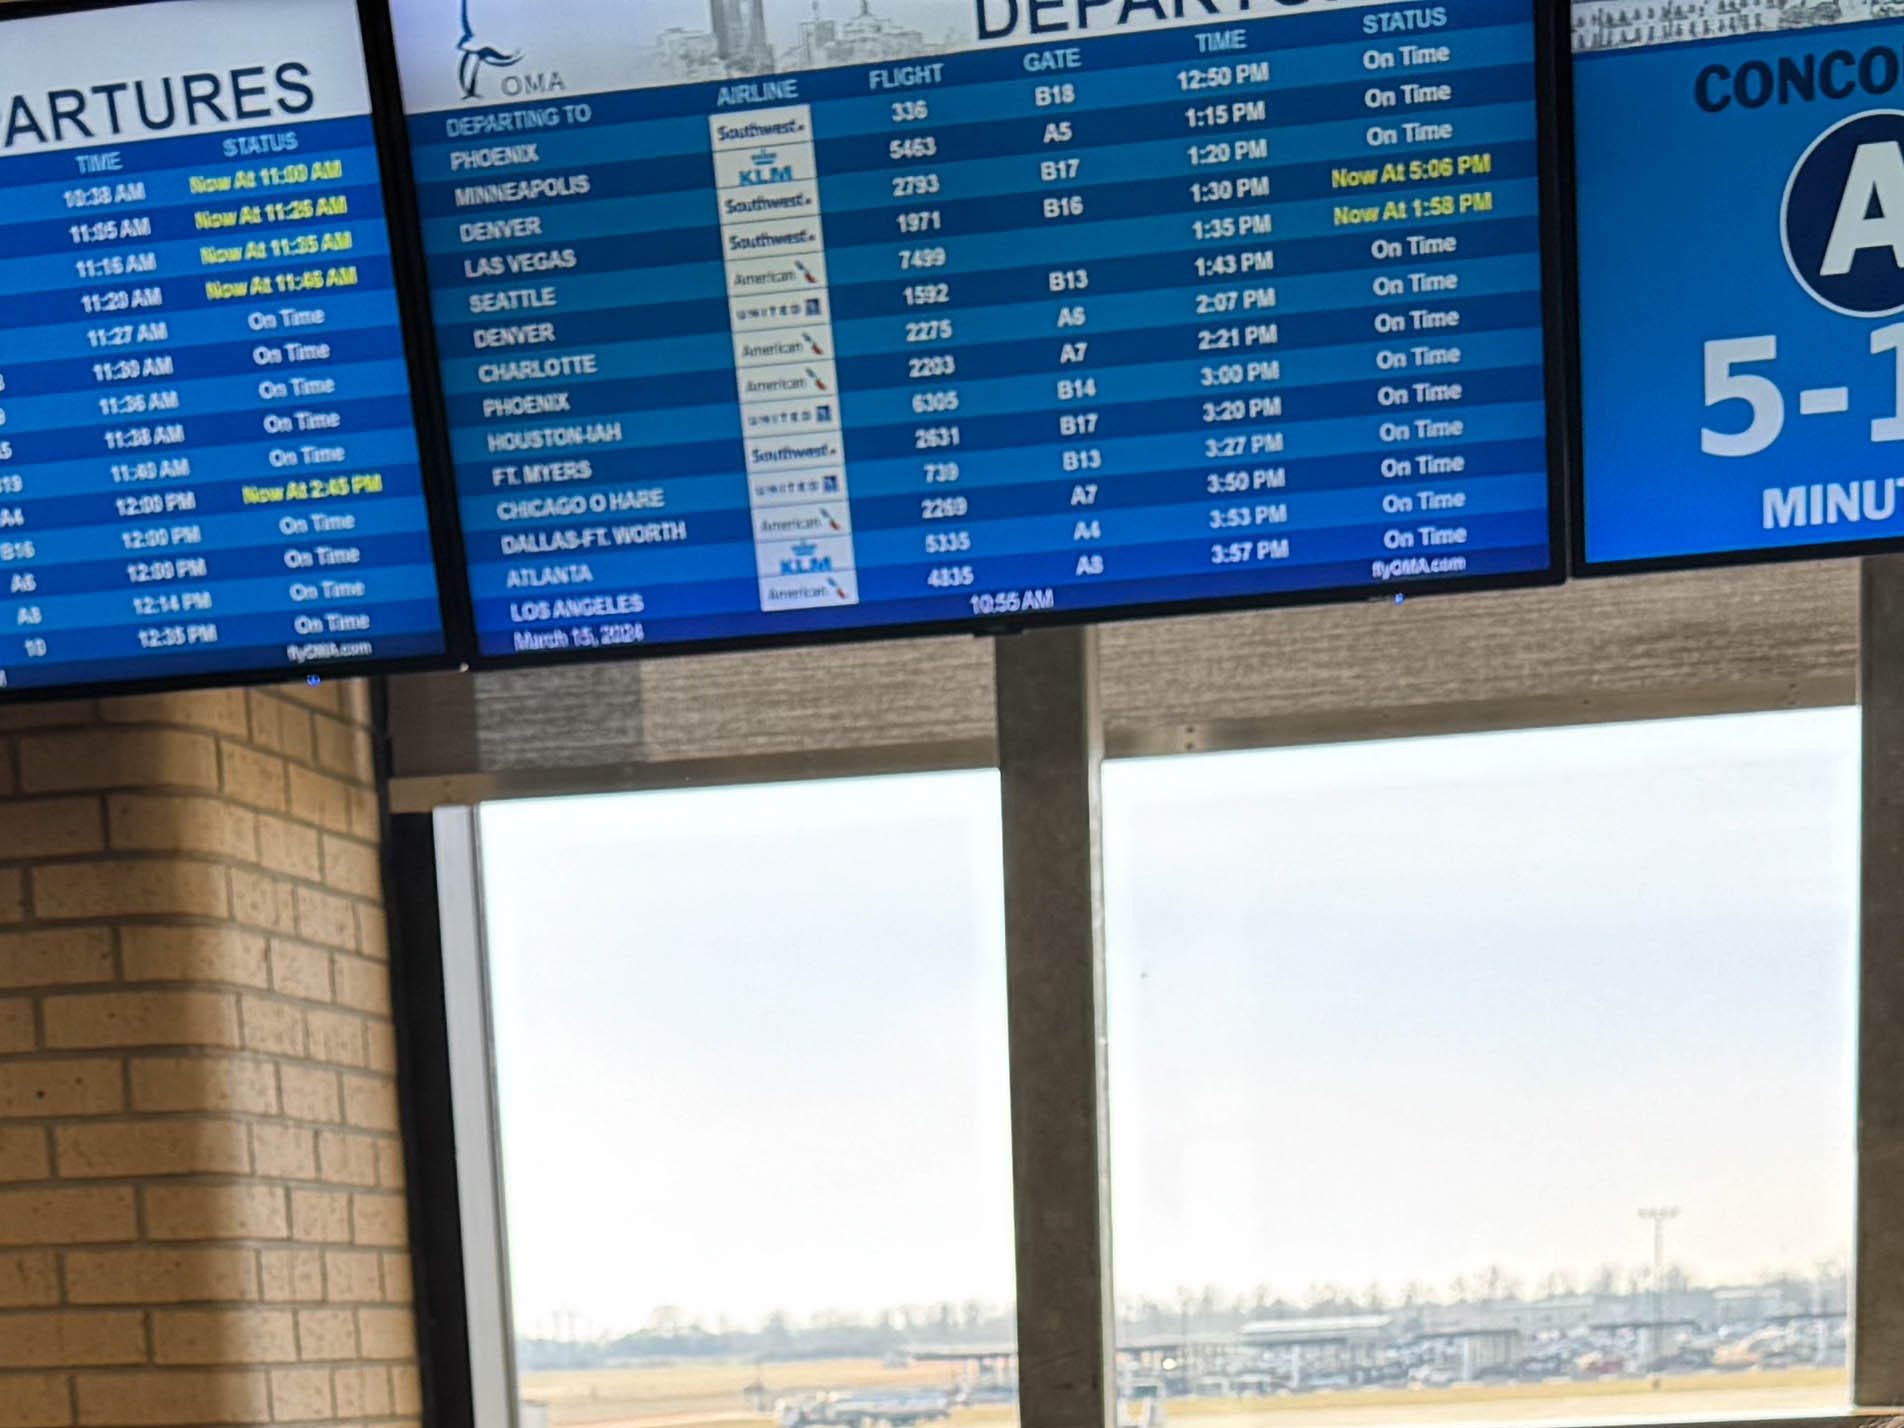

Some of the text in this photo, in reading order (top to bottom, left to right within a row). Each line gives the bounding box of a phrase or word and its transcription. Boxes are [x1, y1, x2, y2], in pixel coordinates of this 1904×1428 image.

[445, 107, 560, 137] DEPARTING
[563, 103, 592, 123] TO
[717, 79, 798, 106] AIRLINE
[868, 62, 944, 89] FLIGHT
[1022, 47, 1082, 72] GATE
[1194, 28, 1247, 52] TIME
[1362, 6, 1447, 34] STATUS
[449, 143, 539, 171] PHOENIX
[891, 99, 928, 122] 336
[1034, 83, 1075, 106] B18
[1177, 66, 1232, 90] 12:50
[1235, 61, 1269, 84] PM
[1362, 49, 1395, 70] On
[1398, 45, 1450, 66] Time
[500, 71, 565, 97] OMA
[454, 83, 1451, 206] MINNEAPOLIS KLM 5463 A5 1:15 PM On Time
[458, 122, 1453, 242] DENVER 2793 B17 1:20 PM On Time
[463, 152, 1491, 278] LAS VEGAS 1971 B16 1:30 PM Now At 5:06 PM
[468, 286, 557, 313] SEATTLE
[1191, 217, 1235, 240] 1:35
[1238, 213, 1272, 235] PM
[1333, 205, 1379, 226] Now
[1382, 200, 1407, 220] At
[1412, 195, 1454, 218] 1:58
[1458, 191, 1492, 213] PM
[472, 235, 1456, 348] DENVER 1592 B13 1:43 PM On Time
[477, 353, 597, 383] CHARLOTTE
[905, 318, 952, 342] 2275
[1195, 290, 1238, 314] 2:07
[1242, 287, 1275, 309] PM
[1372, 276, 1404, 296] On
[1407, 272, 1458, 292] Time
[482, 309, 1459, 417] PHOENIX 2:21 PM On Time
[486, 422, 622, 452] HOUSTON-IAH
[491, 459, 592, 486] FT. MYERS
[495, 487, 664, 521] CHICAGO O HARE
[500, 520, 687, 554] DALLAS-FT. WORTH
[506, 564, 593, 588] ATLANTA
[509, 593, 644, 622] LOS ANGELES
